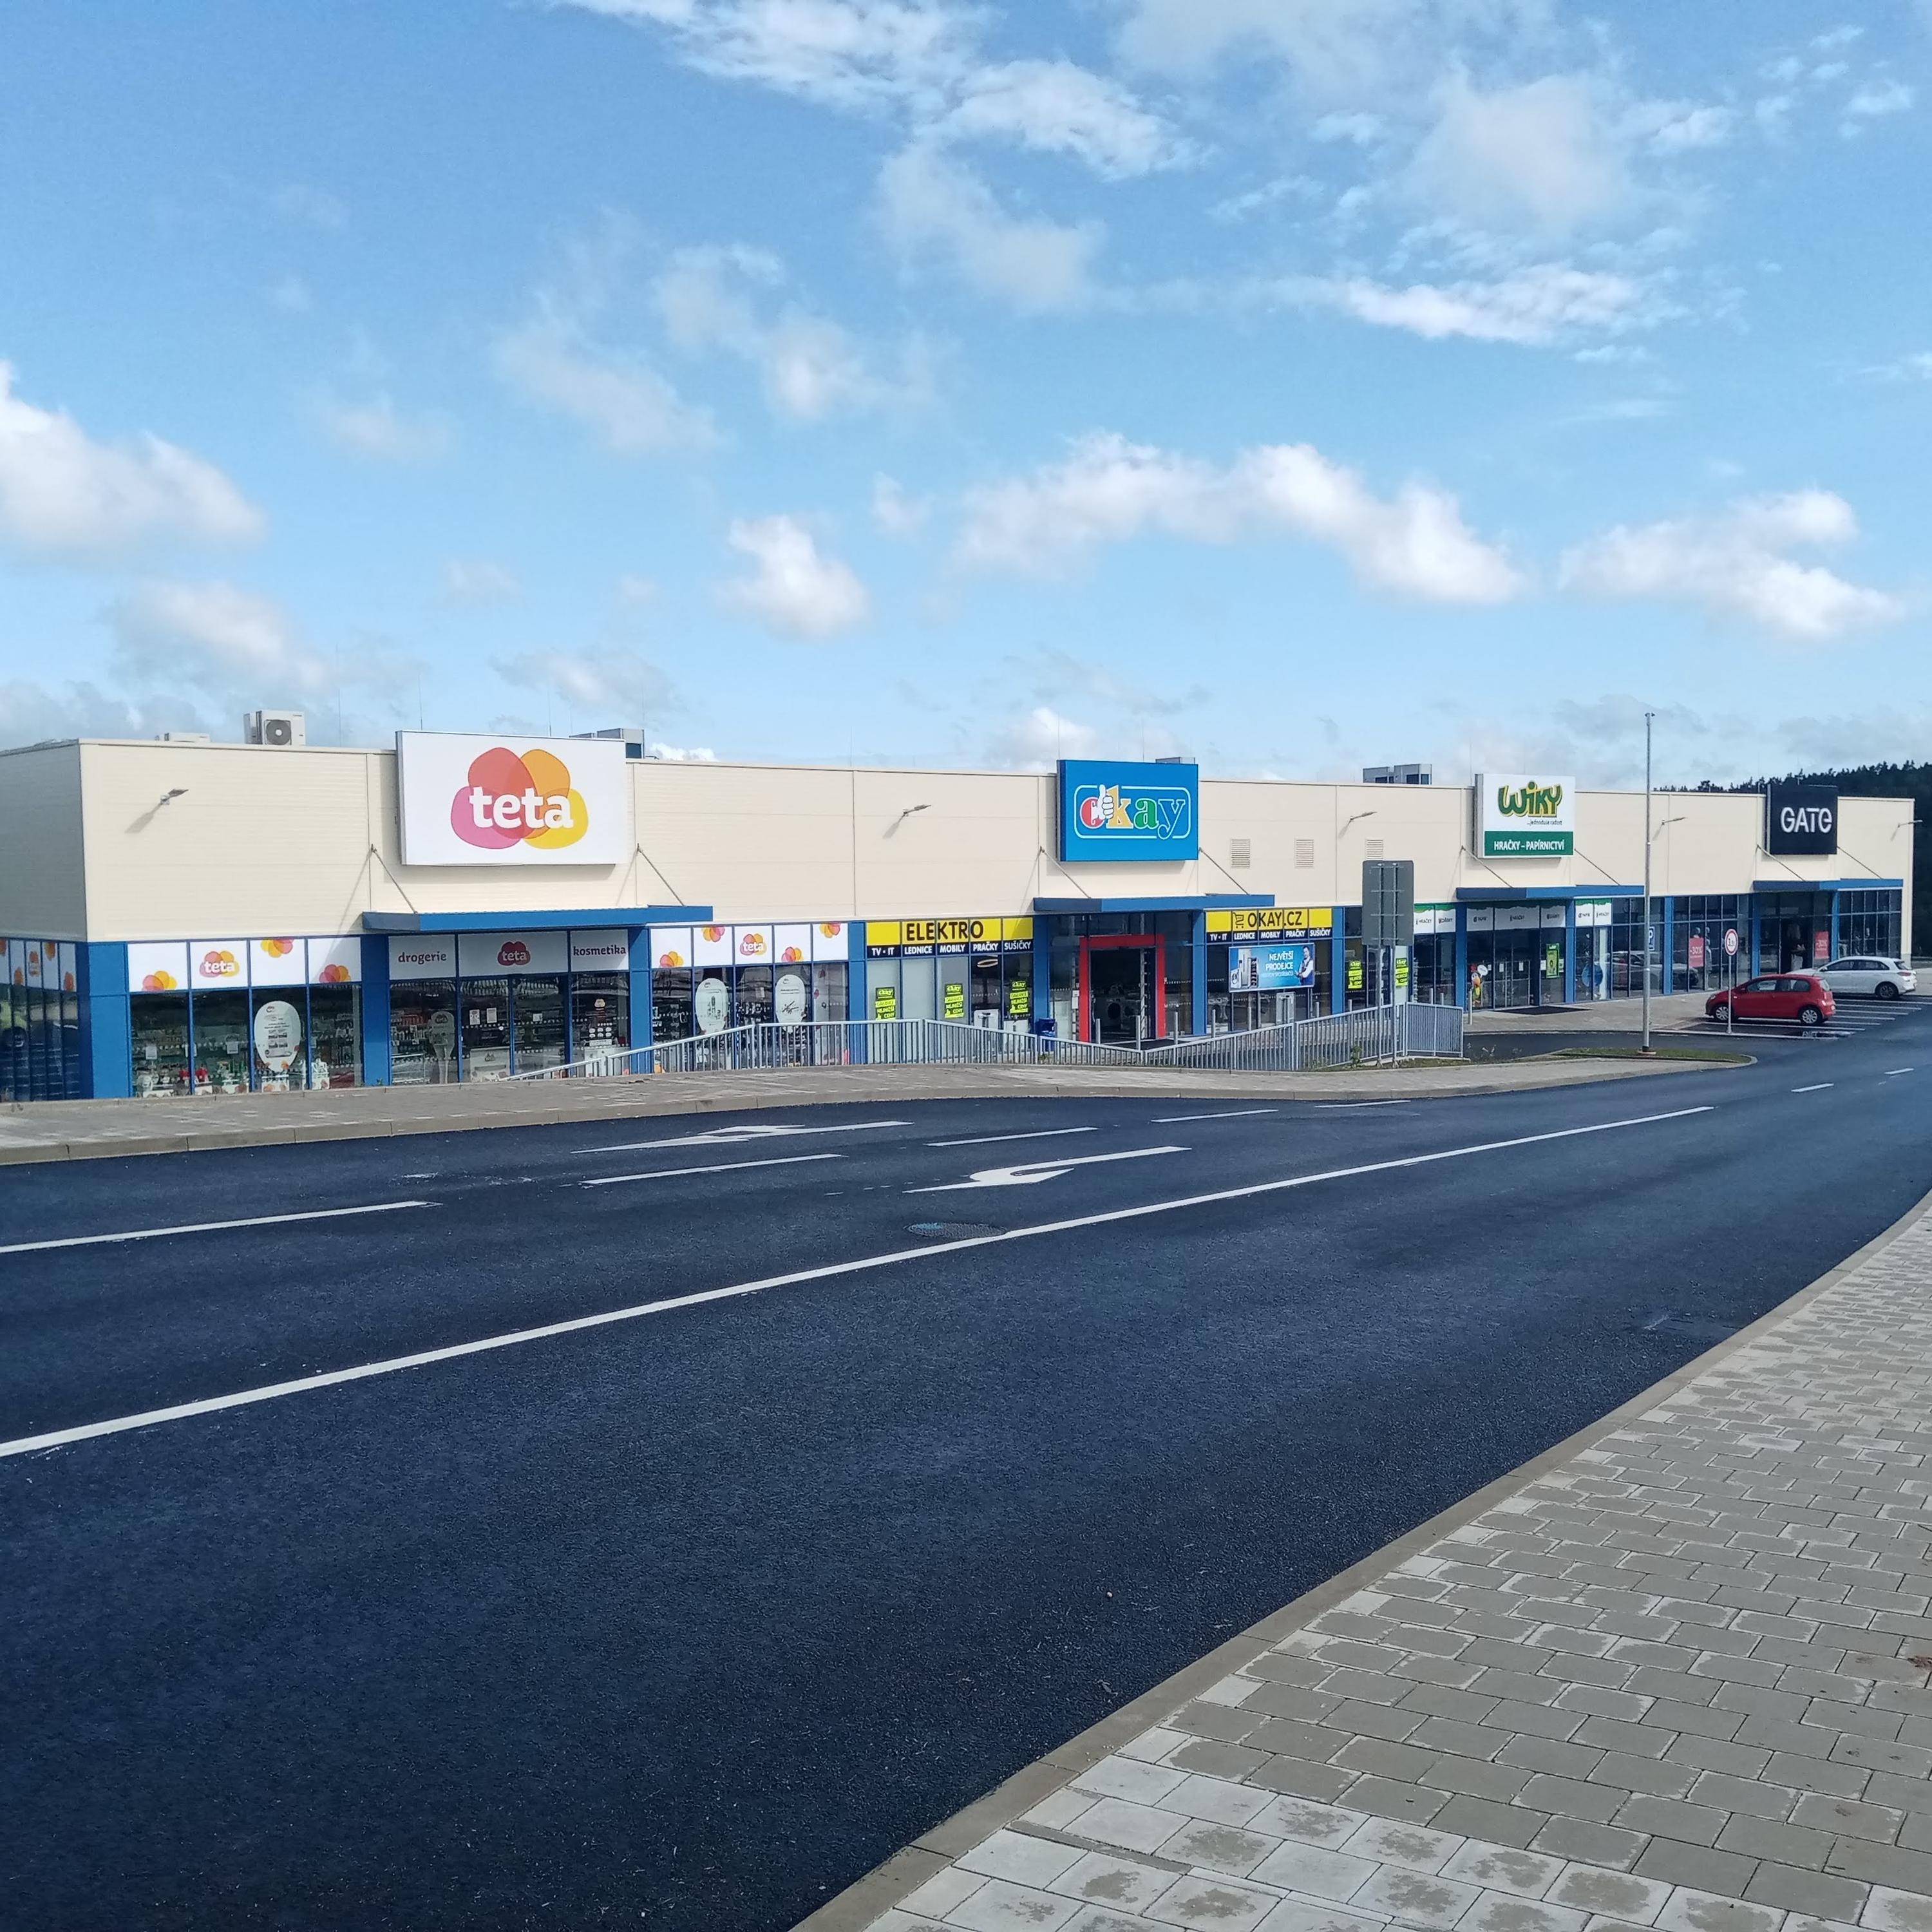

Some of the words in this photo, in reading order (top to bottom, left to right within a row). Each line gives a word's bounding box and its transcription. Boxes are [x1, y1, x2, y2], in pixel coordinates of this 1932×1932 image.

[469, 786, 574, 829] teta
[1494, 839, 1520, 850] HRAČKY
[1526, 839, 1564, 850] PAPÍRNICTVÍ
[1247, 911, 1302, 927] OKAY.CZ
[906, 921, 984, 941] ELEKTRO
[1285, 929, 1305, 938] PRAČKY
[1310, 927, 1331, 937] SUŠIČKY
[573, 945, 627, 956] kosmetika
[742, 942, 764, 952] teta
[904, 945, 933, 954] LEDNICE
[940, 944, 965, 953] MOBILY
[972, 942, 998, 952] PRAČKY
[1004, 941, 1031, 951] SUŠIČKY
[502, 950, 527, 961] teta
[871, 948, 883, 956] TV
[887, 947, 895, 956] IT
[1269, 950, 1294, 961] NEJVĚTŠÍ
[398, 952, 447, 965] drogerie
[204, 958, 236, 974] teta
[1265, 961, 1294, 971] PRODEJCE
